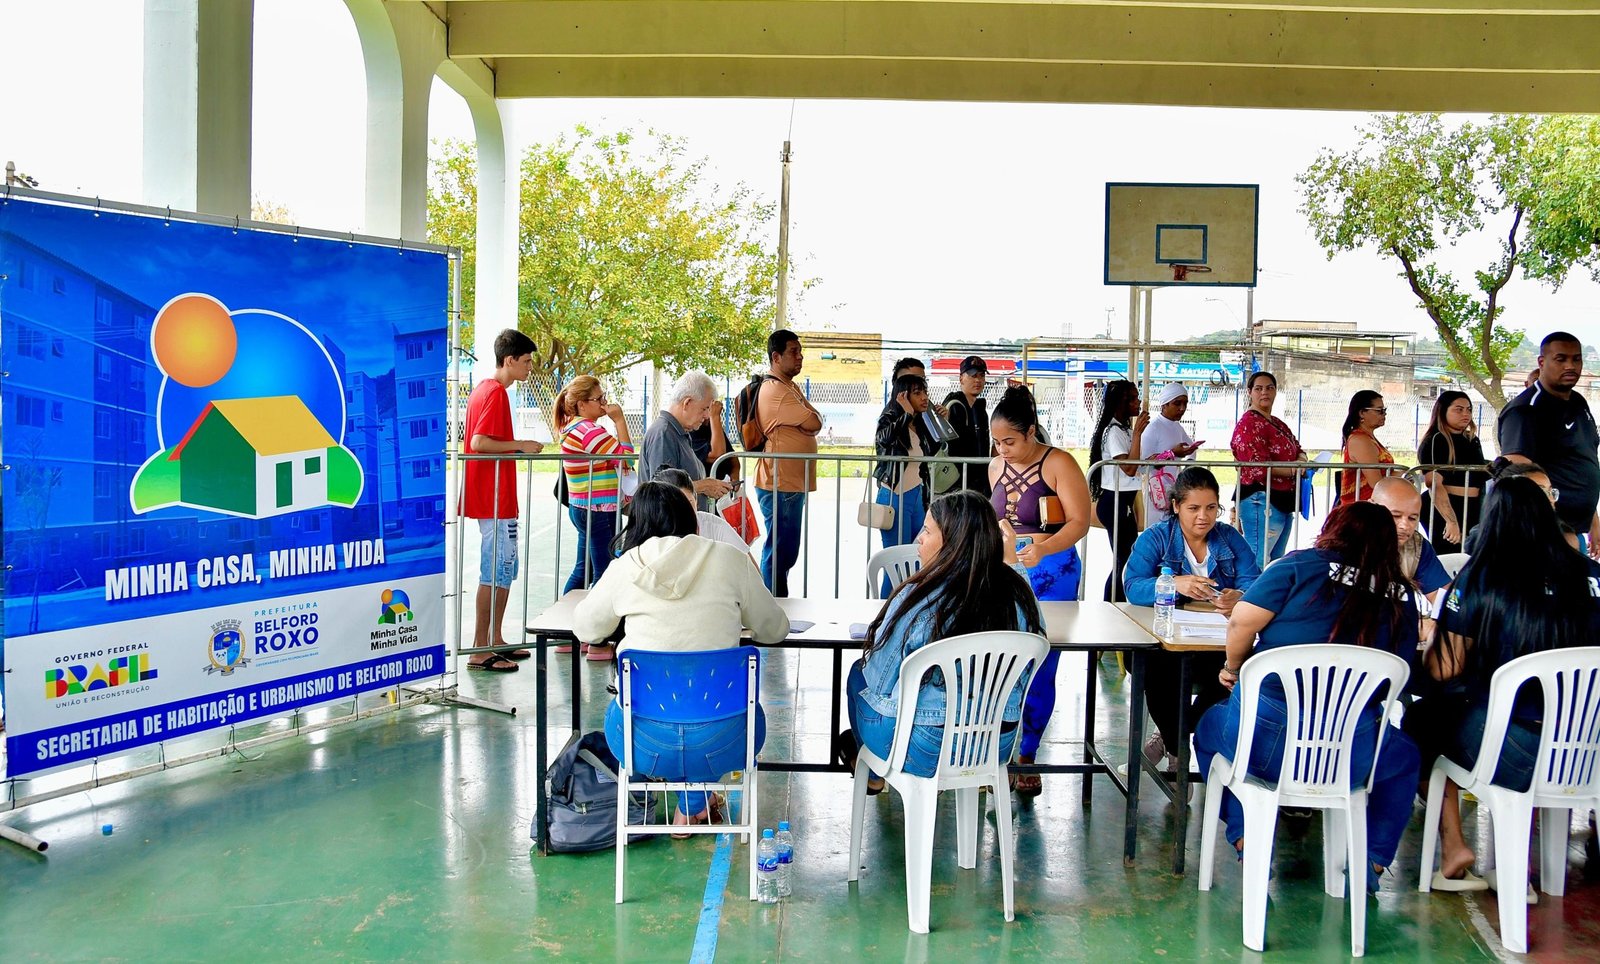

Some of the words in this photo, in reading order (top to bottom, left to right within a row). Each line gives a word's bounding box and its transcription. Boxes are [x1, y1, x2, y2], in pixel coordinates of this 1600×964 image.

[105, 561, 188, 601] MINHA
[197, 553, 262, 588] CASA,
[269, 544, 336, 579] MINHA
[343, 538, 385, 569] VIDA
[254, 602, 318, 617] PREFEITURA
[254, 612, 319, 634] BELFORD
[370, 629, 397, 640] Minha
[398, 625, 418, 635] Casa
[255, 627, 319, 655] ROXO
[370, 639, 398, 651] Minha
[399, 634, 418, 645] Vida
[55, 650, 104, 664] GOVERNO
[107, 642, 150, 655] FEDERAL
[45, 653, 158, 700] BRASIL
[36, 719, 138, 760] SECRETARIA
[143, 713, 163, 736] DE
[167, 693, 245, 730] HABITAÇÃO
[249, 692, 257, 711] E
[261, 676, 334, 708] URBANISMO
[338, 671, 352, 690] DE
[356, 660, 402, 686] BELFORD
[406, 653, 433, 675] ROXO
[55, 699, 81, 709] UNIÃO
[91, 685, 150, 702] RECONSTRUÇÃO
